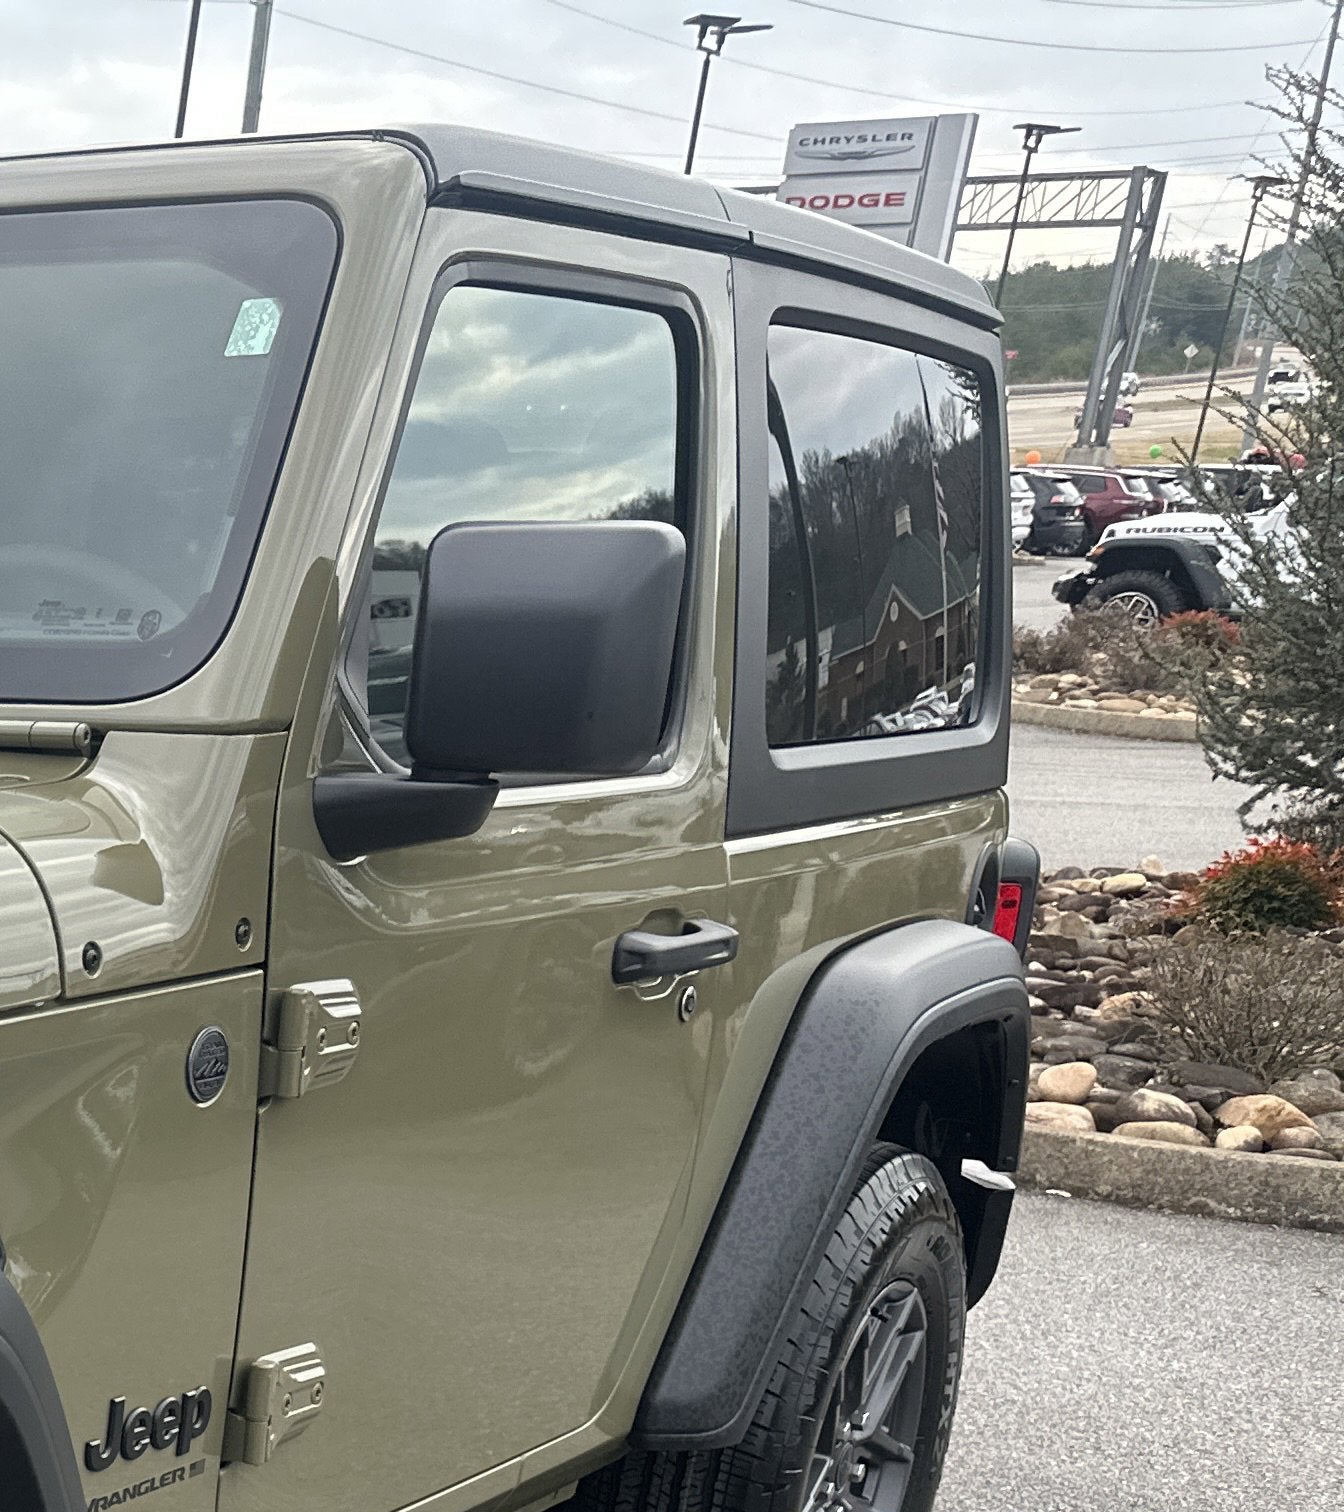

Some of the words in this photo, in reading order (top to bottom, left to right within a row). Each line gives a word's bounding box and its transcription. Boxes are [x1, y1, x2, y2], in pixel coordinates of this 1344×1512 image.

[798, 131, 914, 147] CHRYSLER
[785, 191, 907, 210] DODGE
[1125, 526, 1225, 534] RUBICON
[85, 1385, 212, 1472] Jeep
